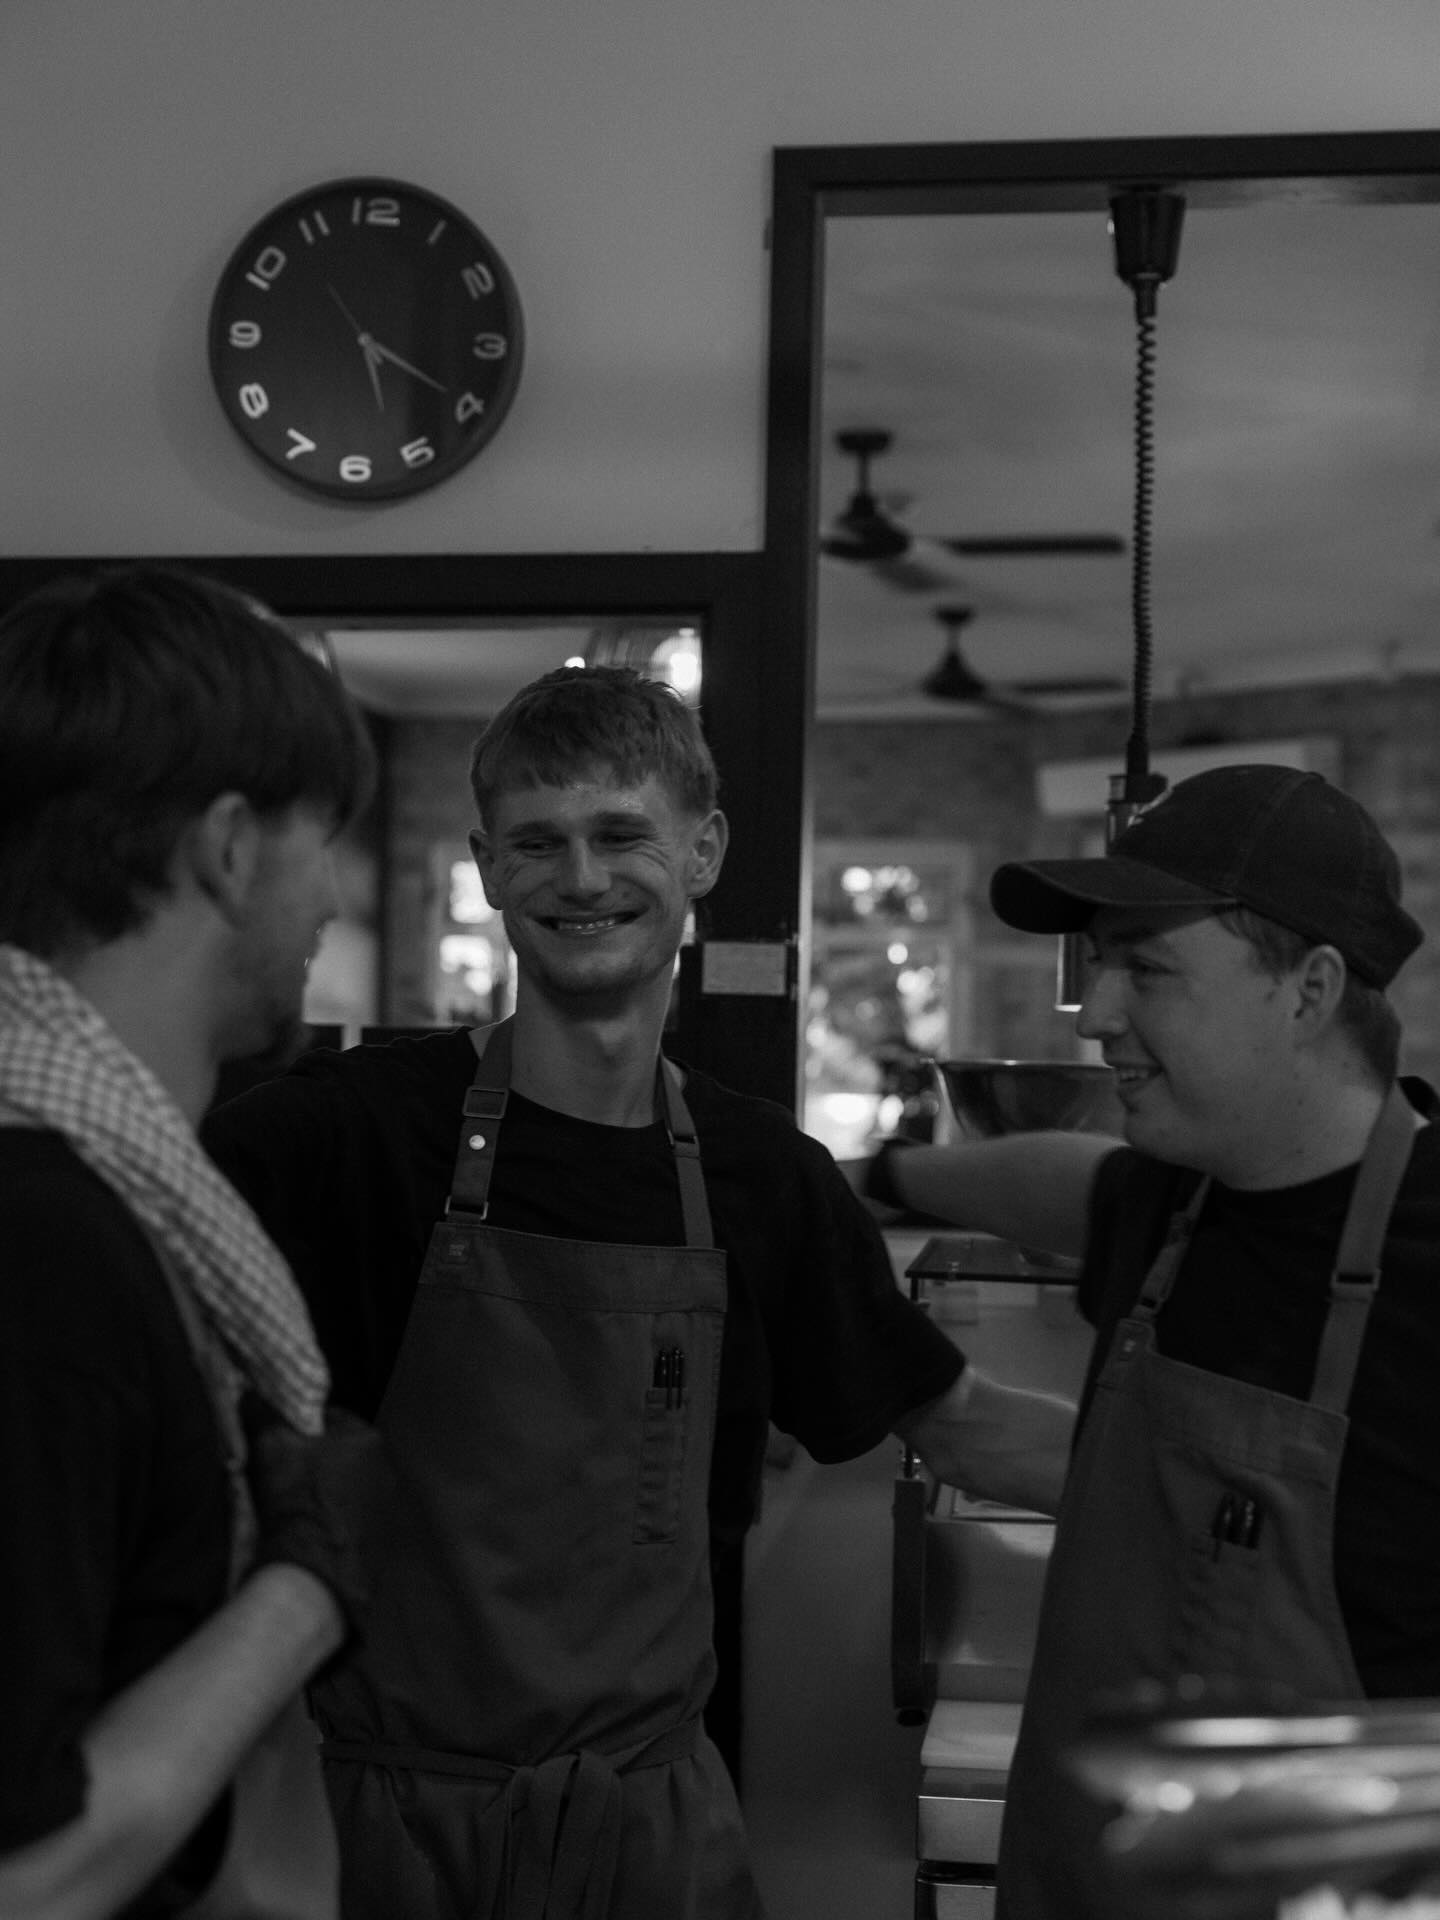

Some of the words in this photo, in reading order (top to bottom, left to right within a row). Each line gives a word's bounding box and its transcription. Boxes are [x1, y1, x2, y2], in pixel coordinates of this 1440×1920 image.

[298, 210, 331, 244] 11
[351, 197, 401, 227] 12
[427, 219, 447, 246] 1
[245, 245, 287, 291] 10
[461, 262, 495, 300] 2
[229, 320, 262, 348] 9
[472, 332, 507, 360] 3
[238, 383, 270, 419] 8
[454, 392, 485, 424] 4
[285, 428, 317, 460] 7
[400, 436, 435, 468] 5
[339, 455, 372, 482] 6
